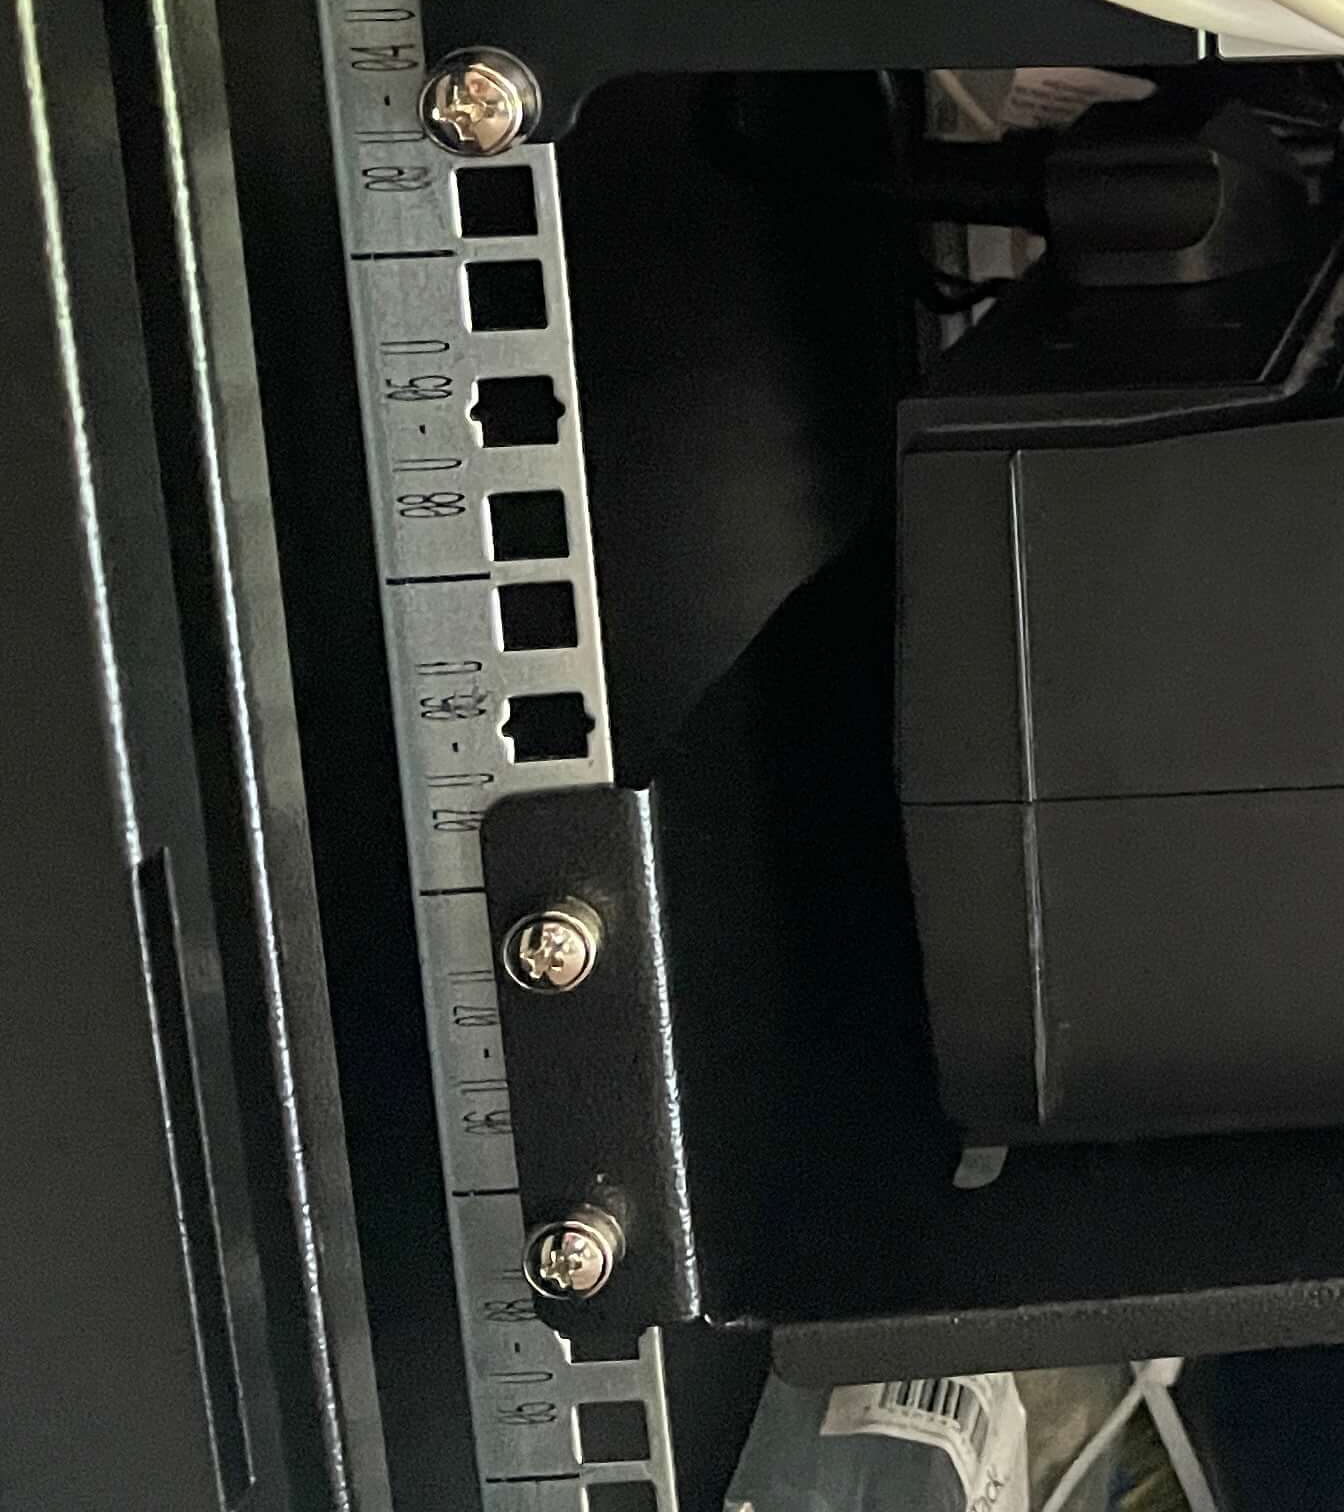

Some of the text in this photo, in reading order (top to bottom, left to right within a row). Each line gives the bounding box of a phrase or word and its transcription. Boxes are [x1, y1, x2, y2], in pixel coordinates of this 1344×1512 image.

[344, 8, 416, 22] U
[349, 43, 419, 71] 04
[380, 340, 450, 355] U
[384, 375, 453, 402] 05
[391, 458, 463, 472] U
[396, 491, 467, 518] 08
[415, 661, 483, 675] U
[425, 773, 495, 788] U
